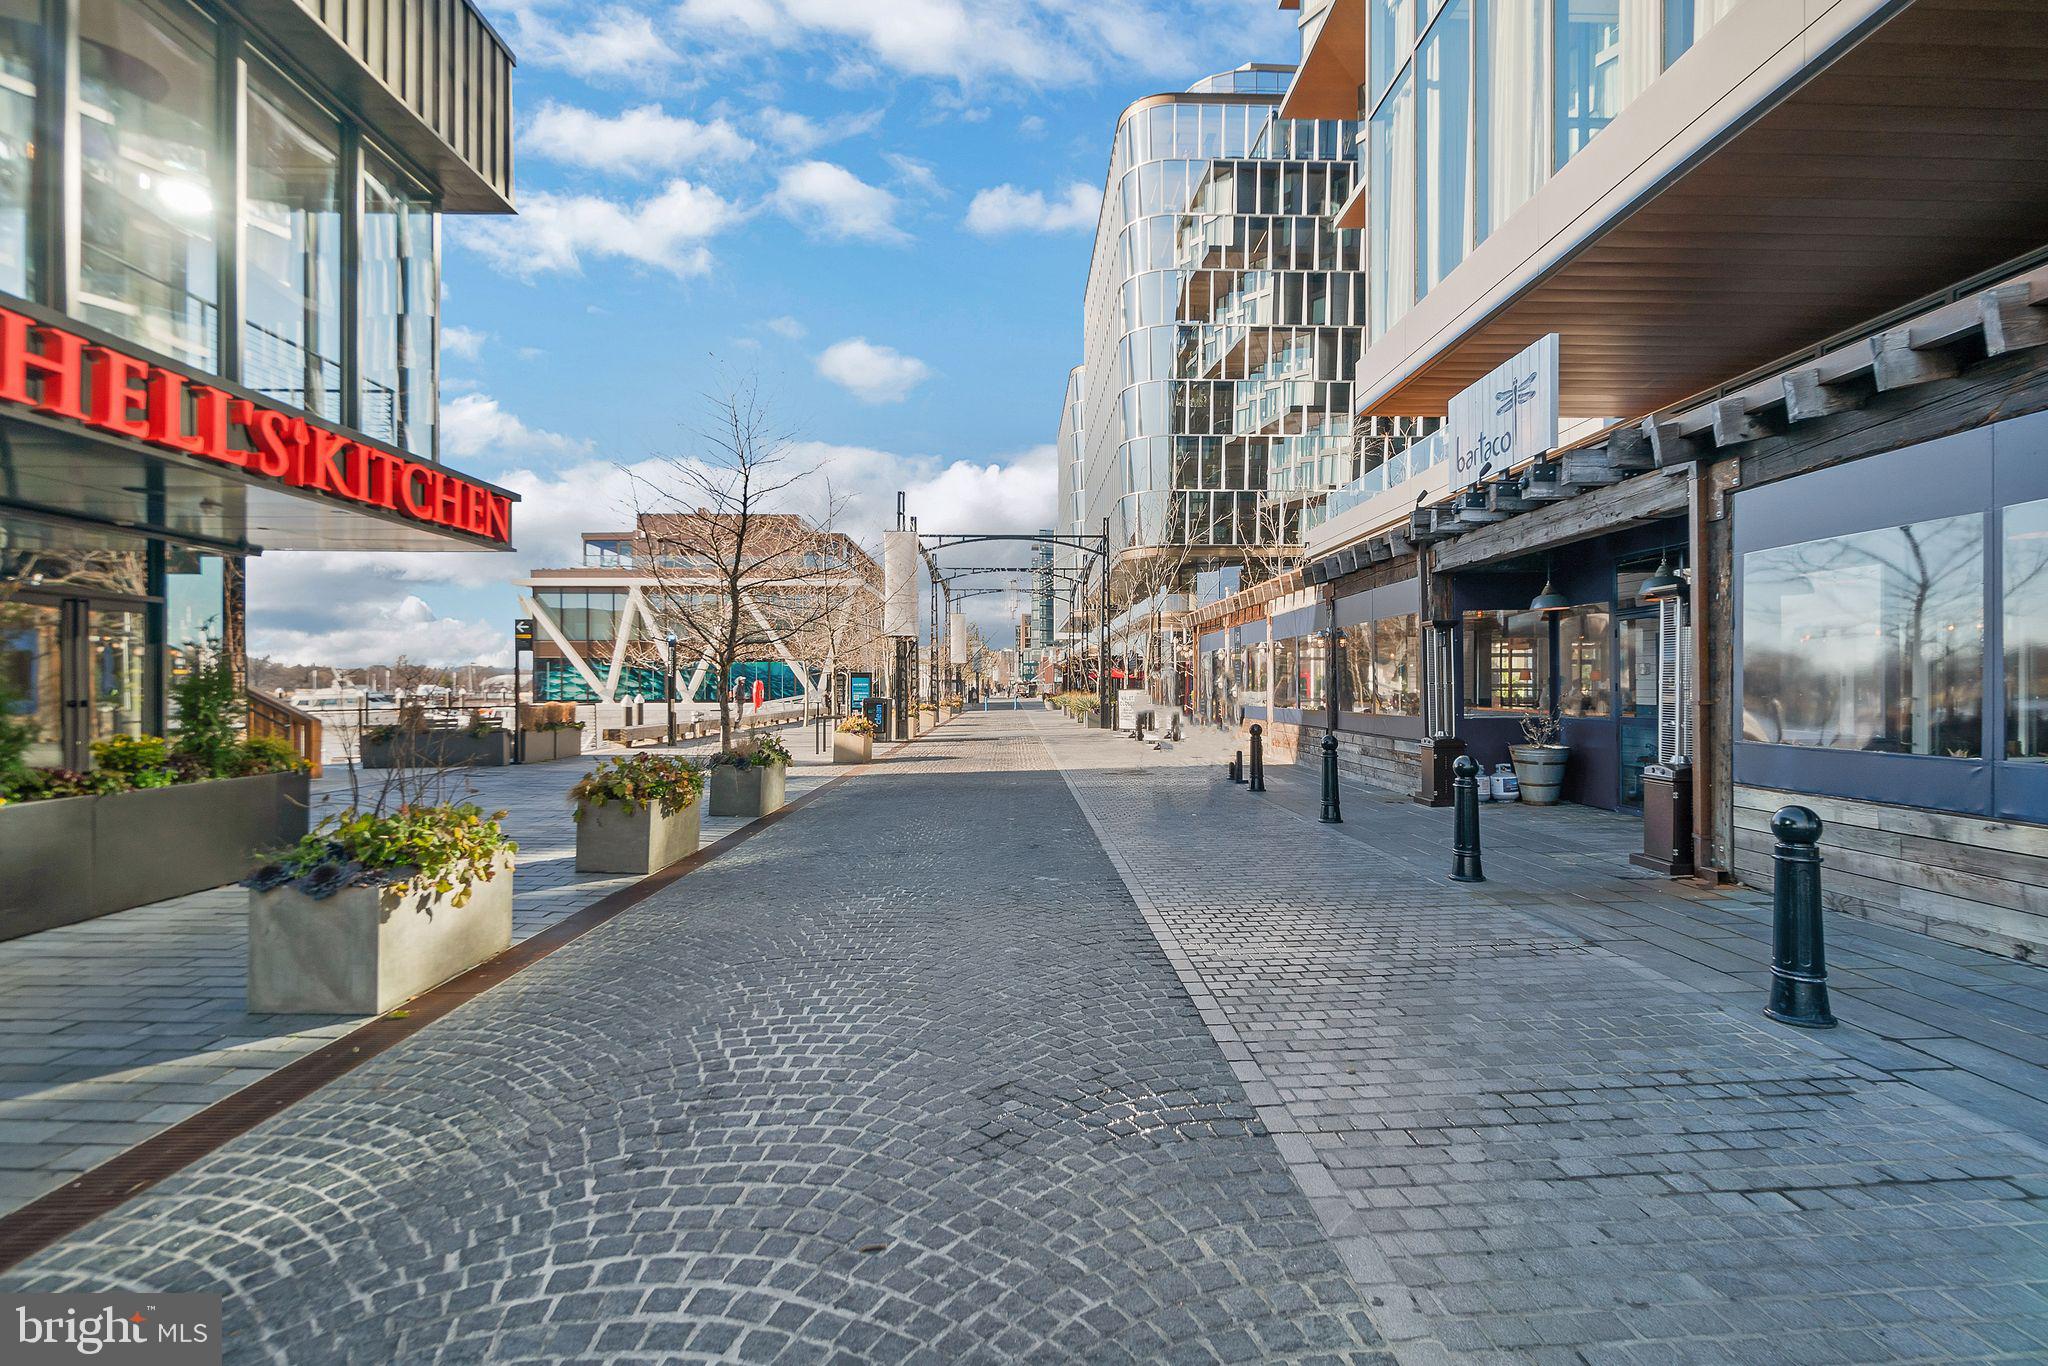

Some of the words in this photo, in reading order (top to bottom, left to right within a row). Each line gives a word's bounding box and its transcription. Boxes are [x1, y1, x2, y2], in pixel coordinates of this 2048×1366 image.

[0, 306, 290, 477] HELL'S
[304, 425, 512, 544] KITCHEN
[1456, 430, 1512, 473] bartaco
